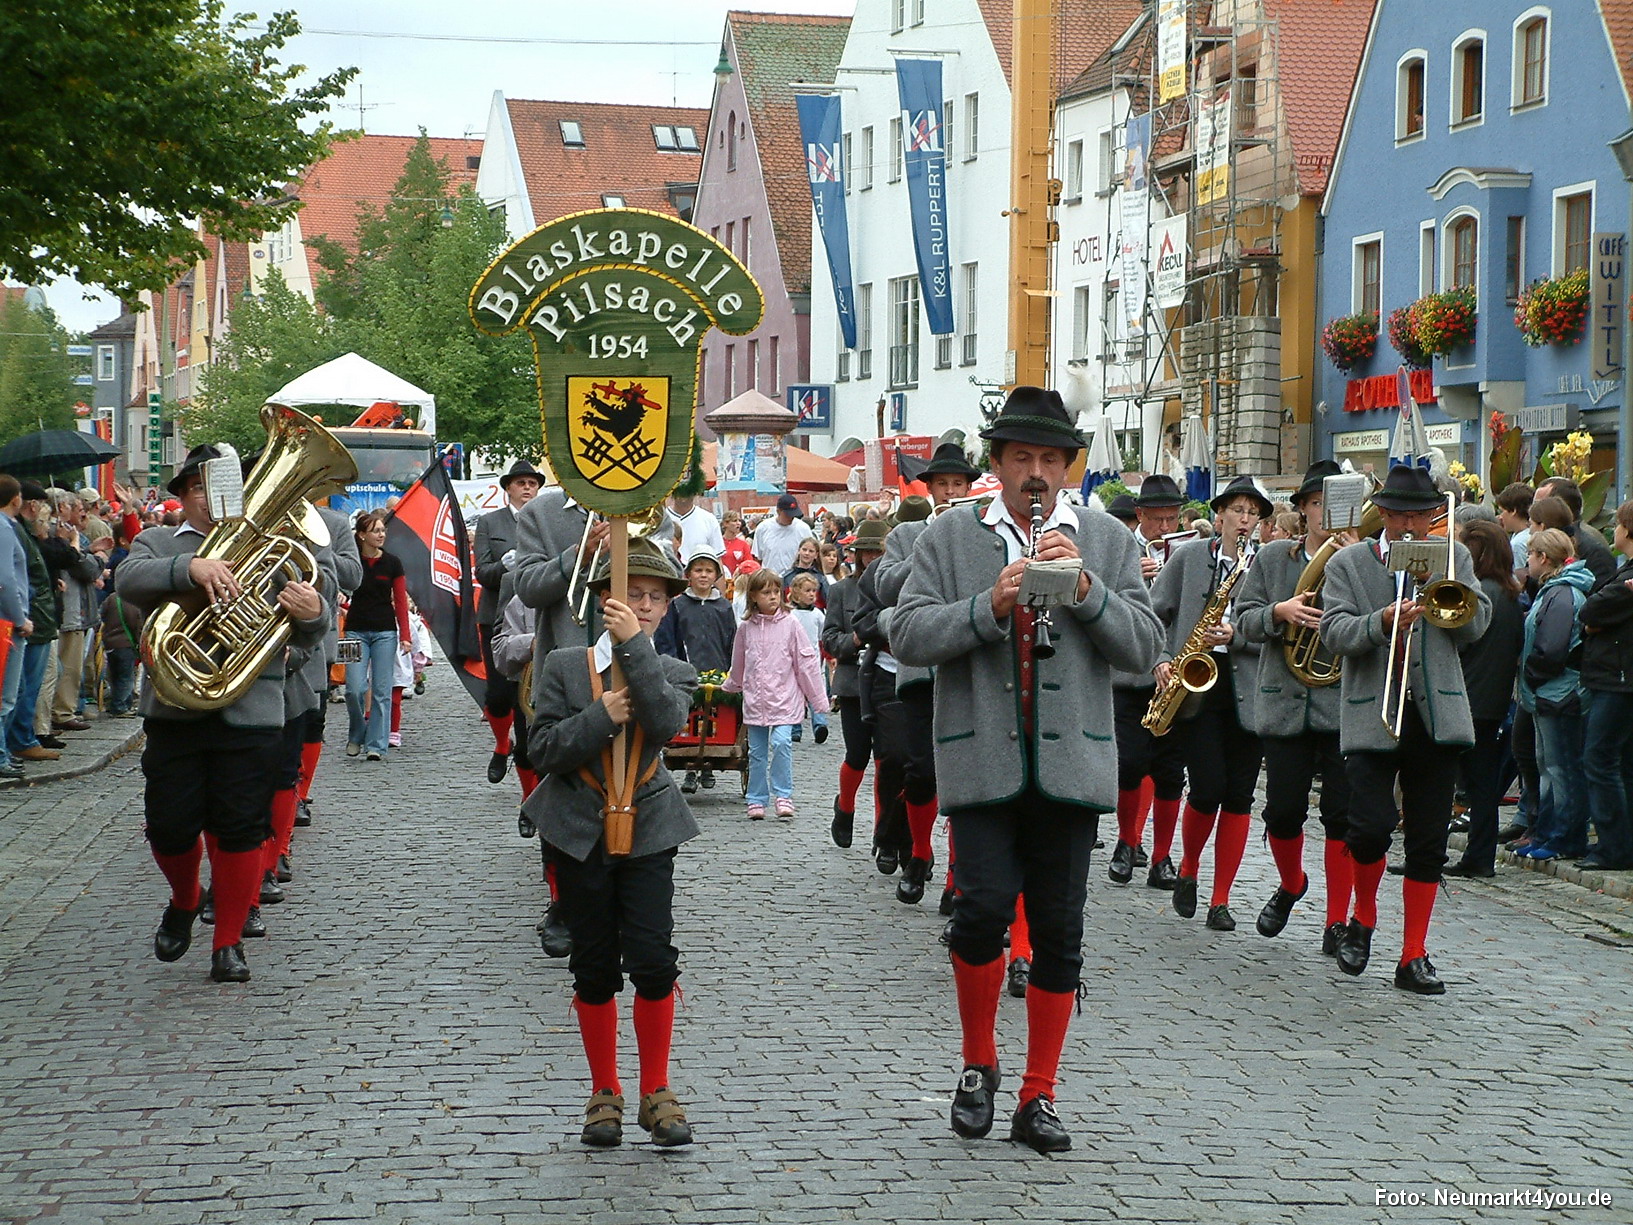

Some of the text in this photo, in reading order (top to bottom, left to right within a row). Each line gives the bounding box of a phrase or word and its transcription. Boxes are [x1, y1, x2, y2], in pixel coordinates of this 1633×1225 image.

[927, 160, 947, 298] K&L RUPPERT
[1073, 235, 1102, 266] HOTEL
[477, 224, 743, 325] Blaskapelle
[530, 281, 698, 347] Pilsach
[1600, 261, 1621, 367] WITTL
[588, 334, 649, 358] 1954
[150, 394, 159, 484] APOTHEKE
[1361, 433, 1383, 445] APOTHEKE
[1429, 427, 1453, 440] APOTHEKE
[345, 484, 386, 493] uptschule
